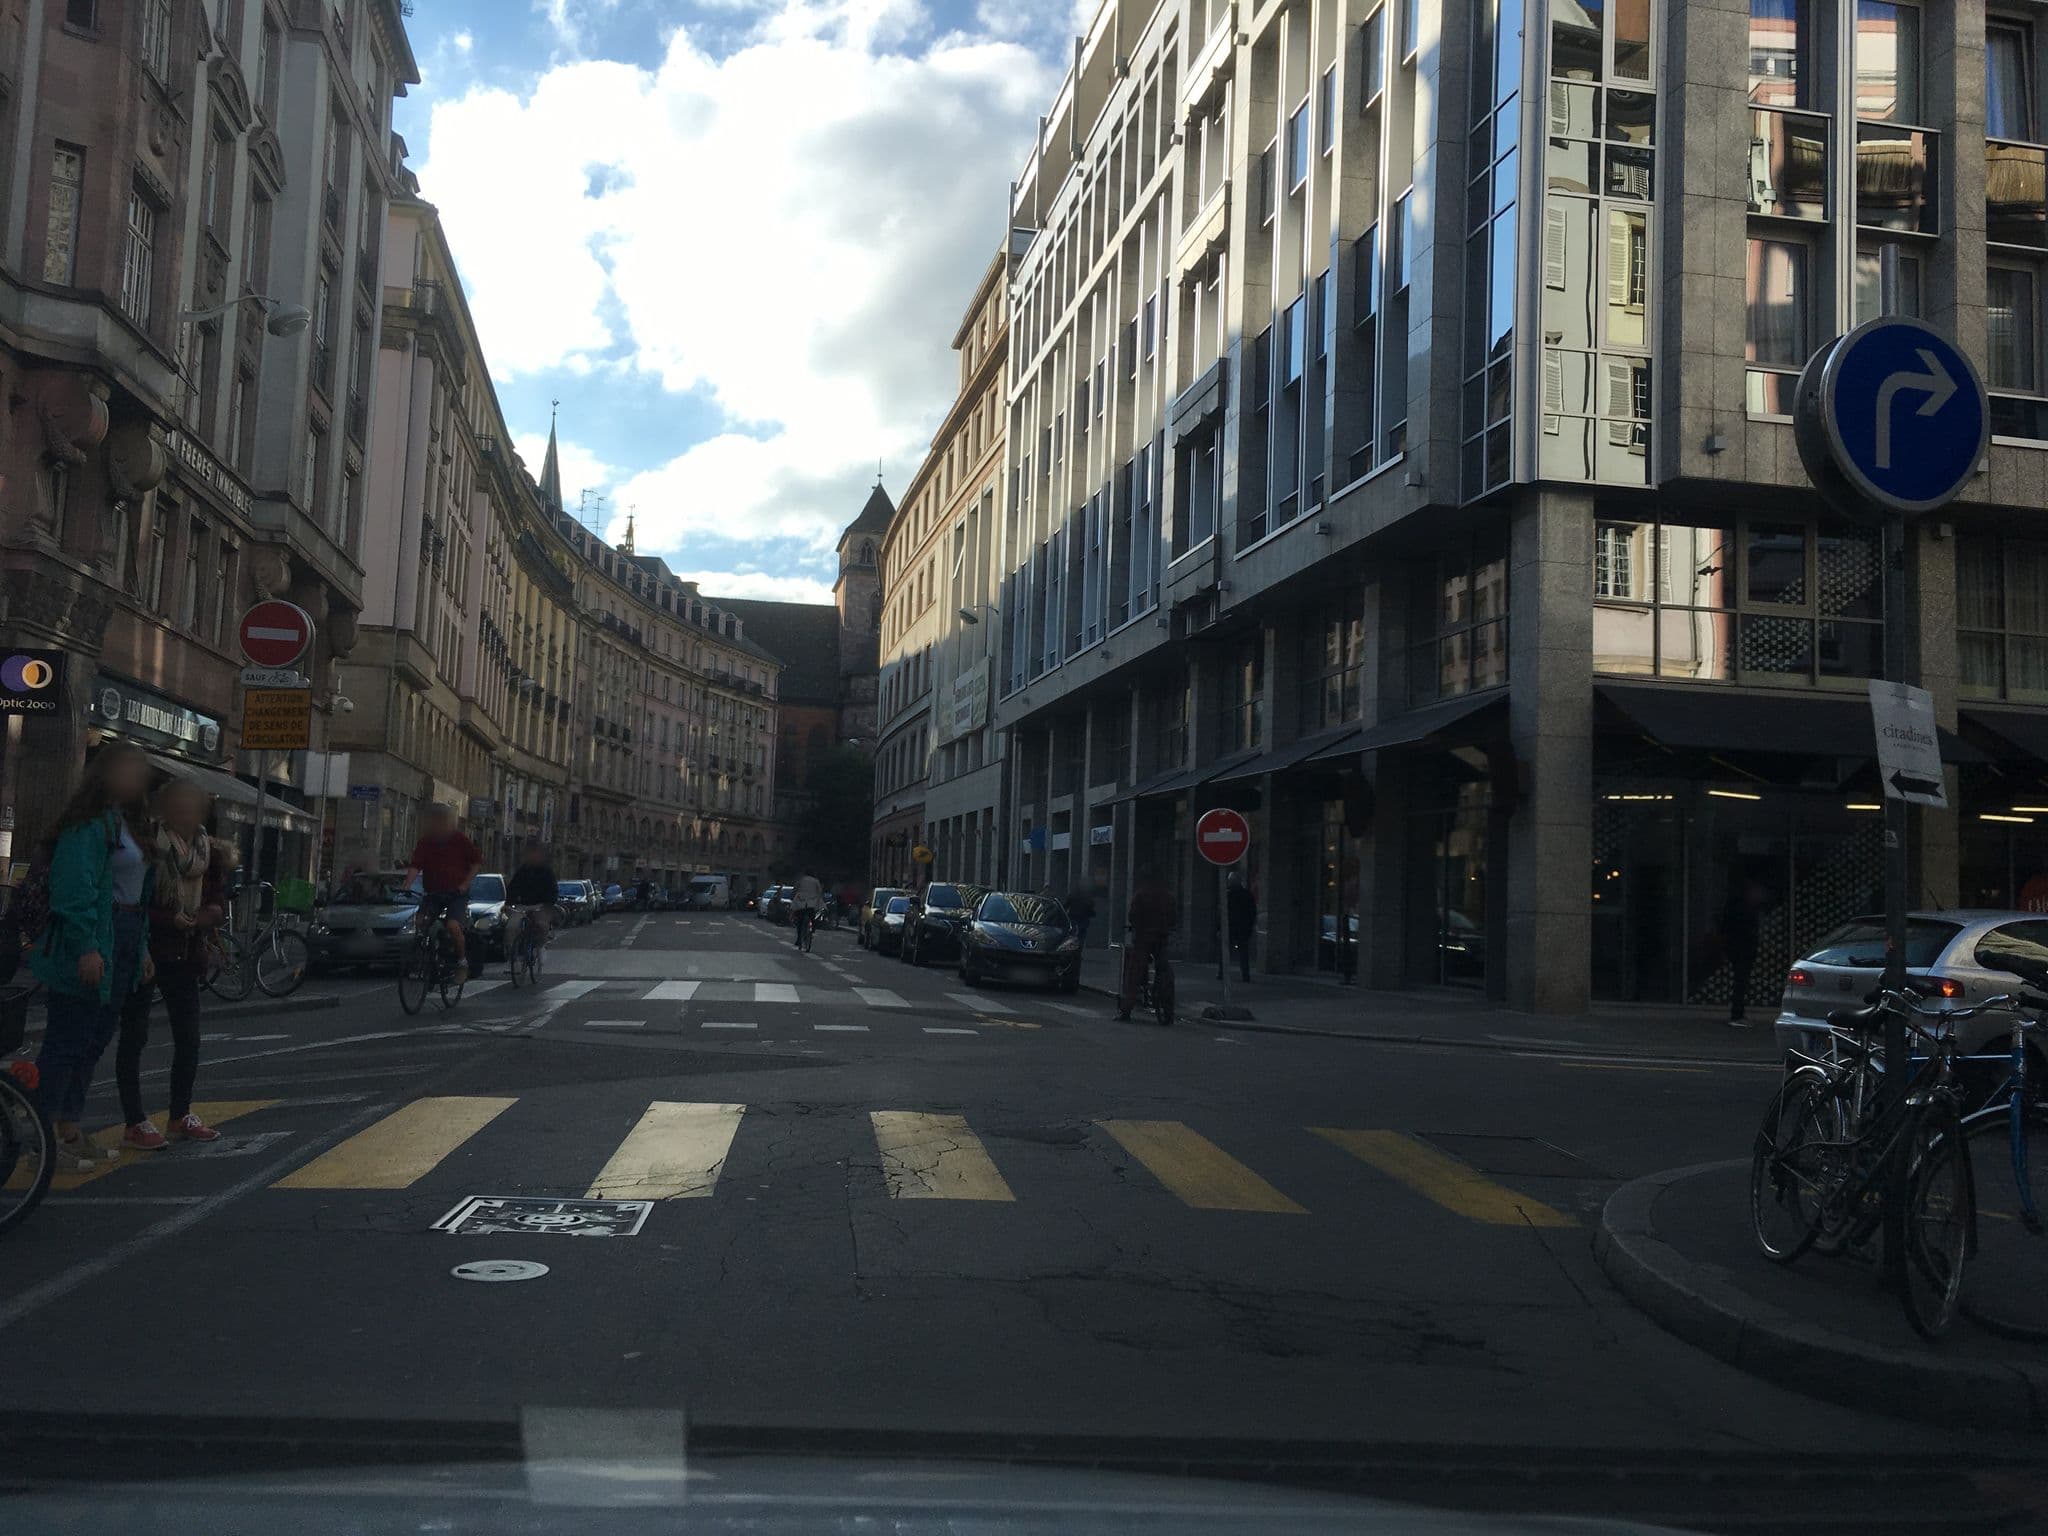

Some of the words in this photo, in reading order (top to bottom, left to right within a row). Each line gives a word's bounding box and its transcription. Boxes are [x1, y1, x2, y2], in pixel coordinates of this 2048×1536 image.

[245, 673, 267, 681] SAUF
[253, 693, 304, 704] ATTENTION
[245, 706, 309, 717] CHANGEMENT
[248, 719, 262, 731] DE
[290, 719, 304, 731] DE
[246, 734, 306, 745] CIRCULATION
